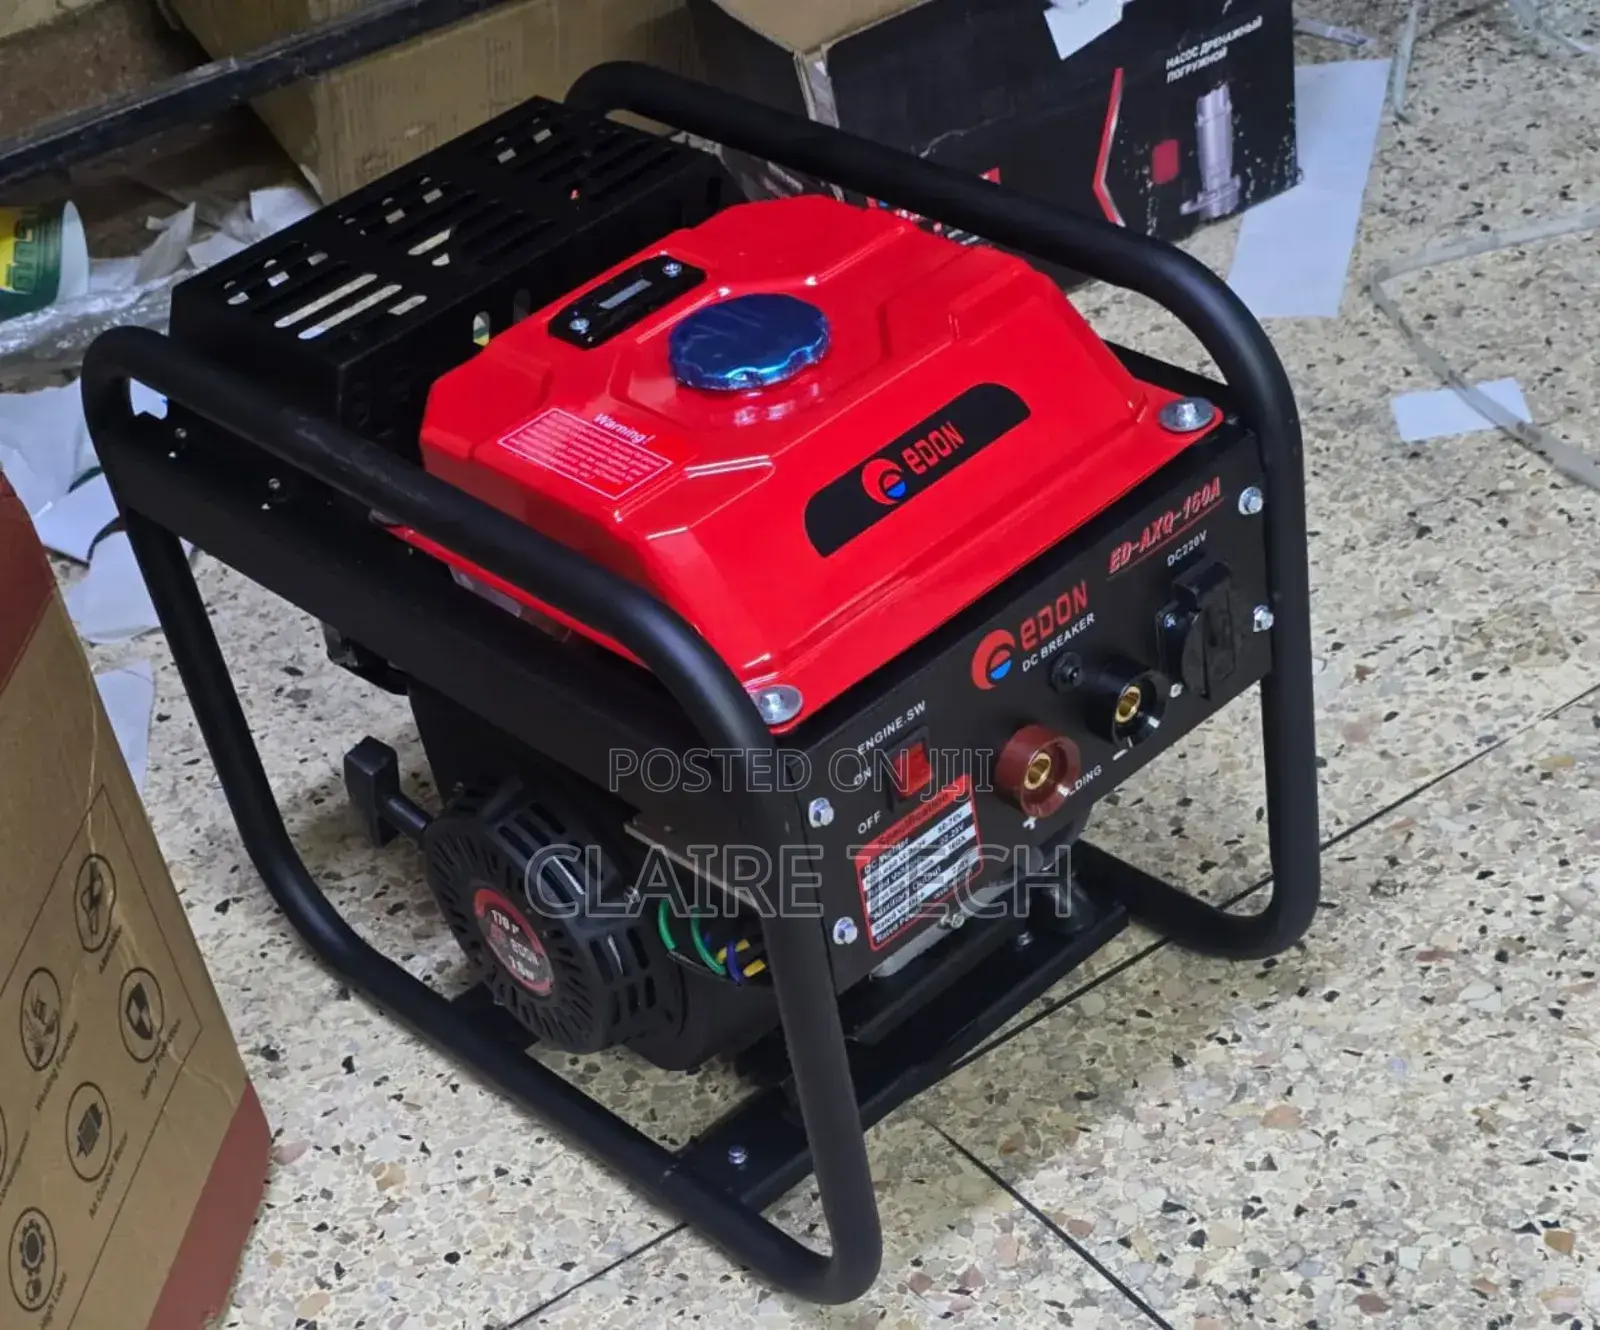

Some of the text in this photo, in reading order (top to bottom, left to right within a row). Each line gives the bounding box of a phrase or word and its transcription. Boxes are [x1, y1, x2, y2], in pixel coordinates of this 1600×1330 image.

[1166, 529, 1208, 568] DC220V
[1021, 612, 1096, 673] DC BREAKER
[857, 700, 927, 755] ENGINE.SW
[857, 810, 882, 834] OFF
